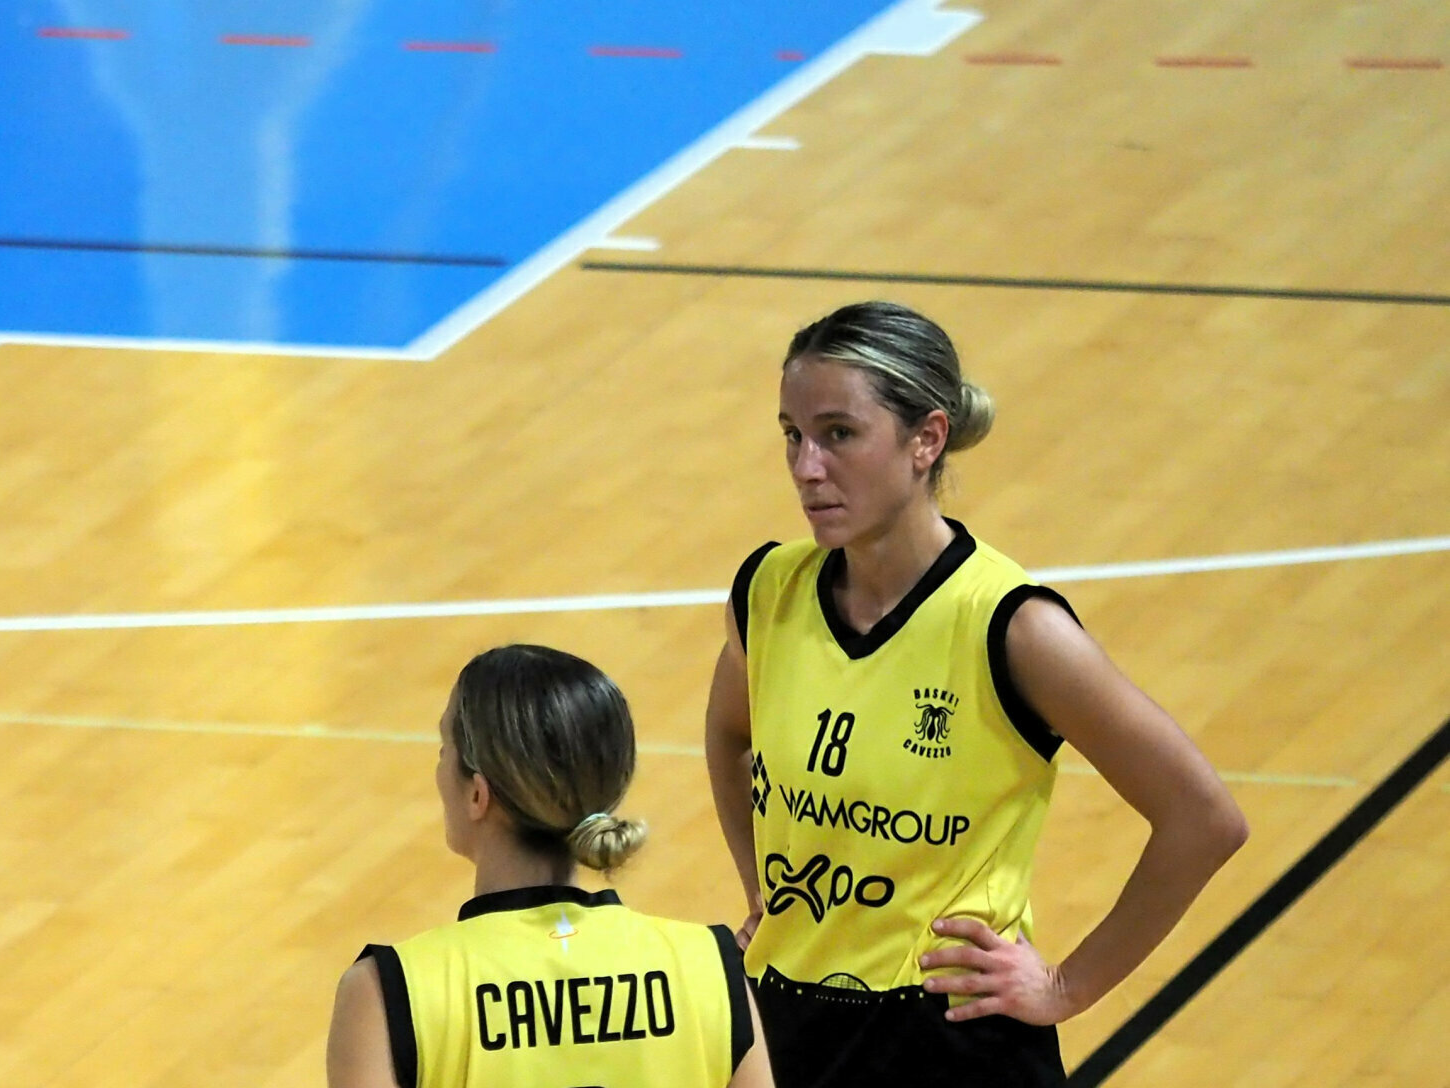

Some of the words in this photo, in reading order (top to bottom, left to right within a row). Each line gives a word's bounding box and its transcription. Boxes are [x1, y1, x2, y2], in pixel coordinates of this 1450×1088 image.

[806, 708, 856, 778] 18
[902, 738, 952, 759] CAVEZZO
[778, 784, 971, 846] WAMGROUP
[475, 970, 675, 1051] CAVEZZO
